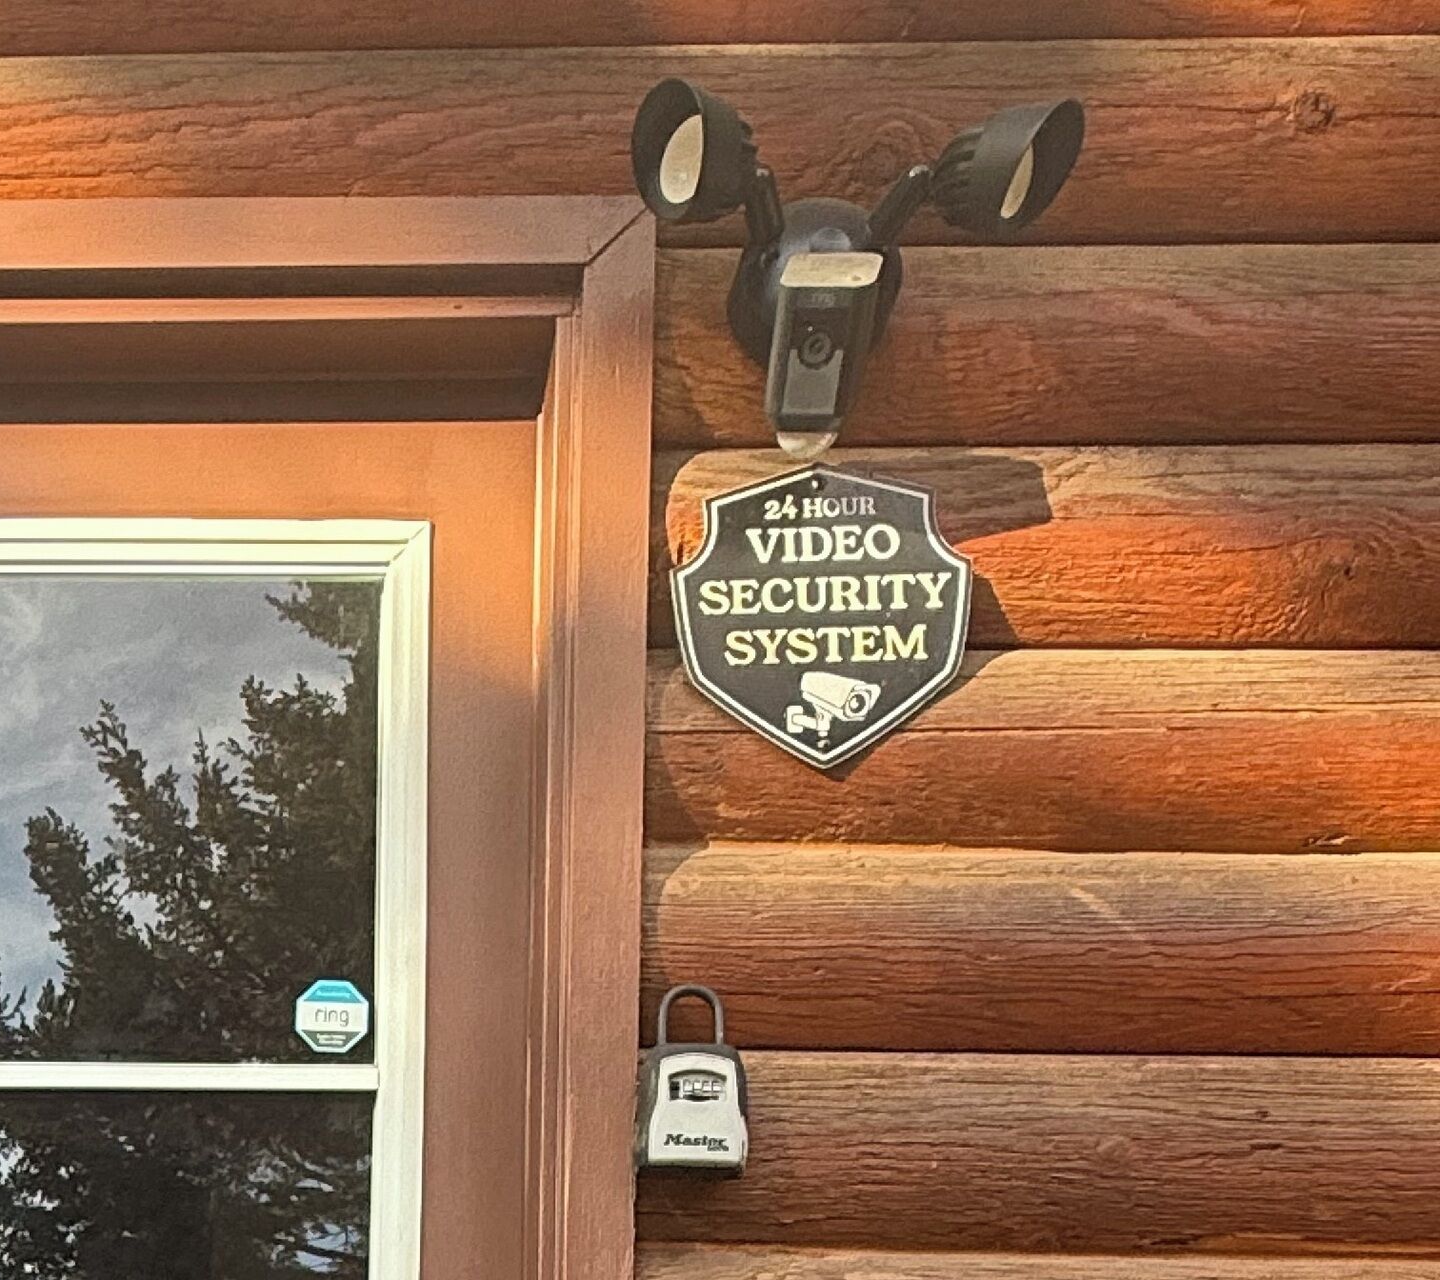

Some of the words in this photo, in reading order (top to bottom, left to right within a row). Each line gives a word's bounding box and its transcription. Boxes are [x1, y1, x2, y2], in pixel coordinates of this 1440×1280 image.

[764, 495, 798, 520] 24
[803, 497, 876, 517] HOUR
[745, 525, 900, 564] VIDEO
[698, 572, 951, 615] SECURITY
[724, 625, 928, 666] SYSTEM
[315, 1007, 349, 1027] ring
[664, 1134, 727, 1146] Master
